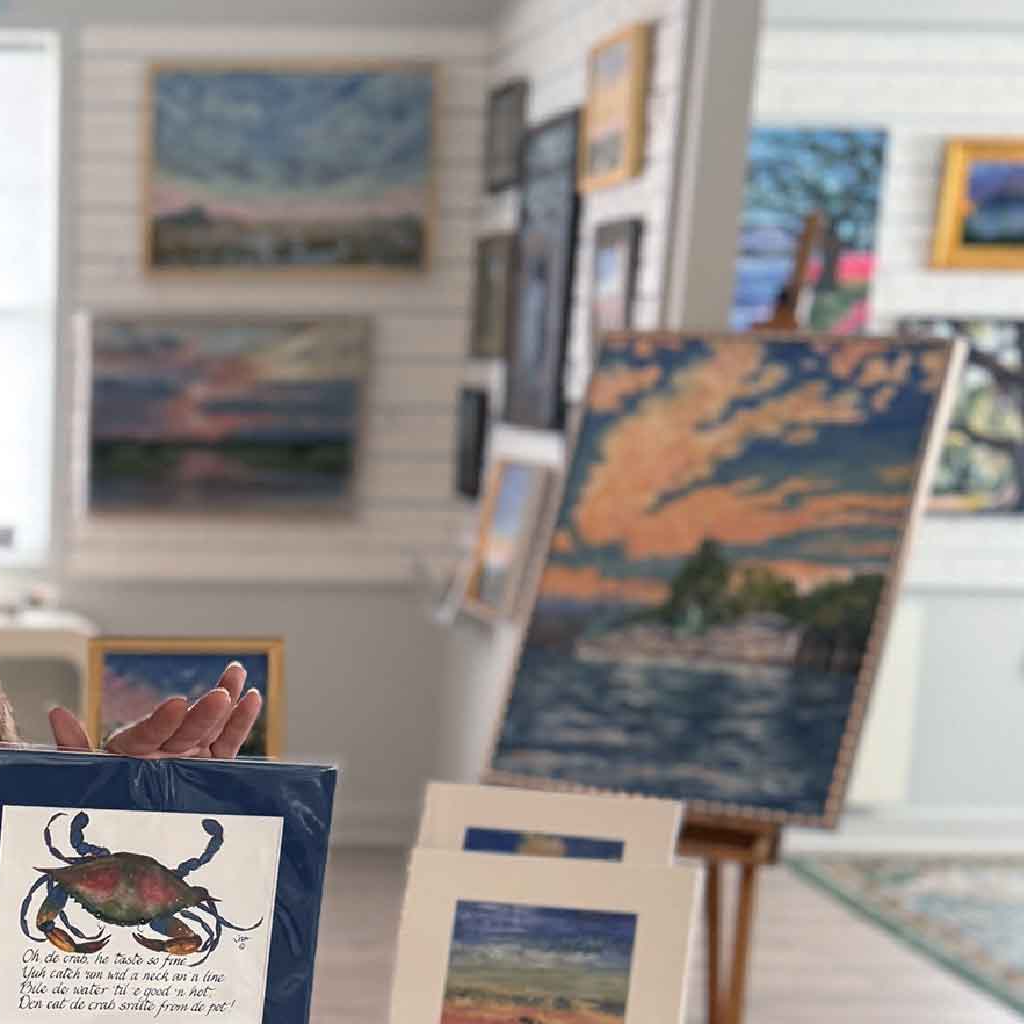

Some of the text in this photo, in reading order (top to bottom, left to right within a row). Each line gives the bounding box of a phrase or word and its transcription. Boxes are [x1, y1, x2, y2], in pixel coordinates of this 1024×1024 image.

[22, 948, 40, 964] Oh
[44, 950, 60, 964] de
[95, 951, 109, 965] he
[114, 952, 144, 965] taste
[146, 956, 160, 966] so
[49, 967, 81, 980] catch
[130, 972, 139, 981] a
[143, 969, 169, 982] neck
[190, 972, 199, 982] a
[202, 969, 225, 983] line
[51, 981, 70, 995] de
[72, 983, 107, 996] water
[142, 985, 172, 1001] good
[69, 997, 87, 1011] de
[87, 999, 116, 1011] crab
[153, 1000, 189, 1018] from
[189, 1001, 205, 1012] de
